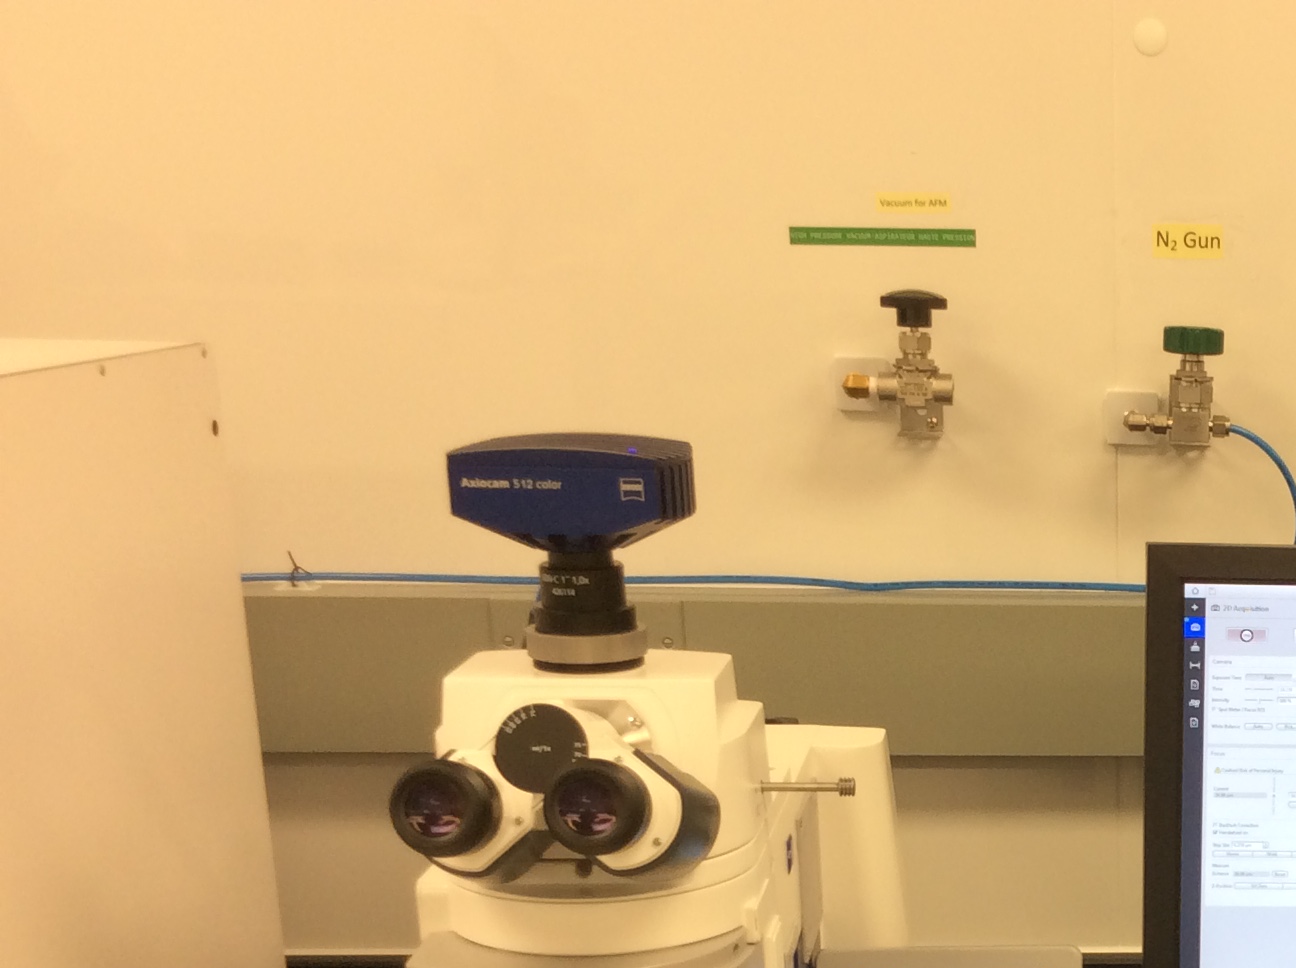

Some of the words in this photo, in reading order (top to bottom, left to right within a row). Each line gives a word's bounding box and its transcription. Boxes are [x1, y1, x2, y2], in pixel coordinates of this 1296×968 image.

[879, 198, 913, 207] Vacuum
[914, 198, 926, 207] for
[928, 199, 947, 207] AFM
[1183, 231, 1221, 249] Gun
[460, 477, 511, 489] Axiocam
[512, 478, 534, 490] 512
[536, 479, 562, 490] color
